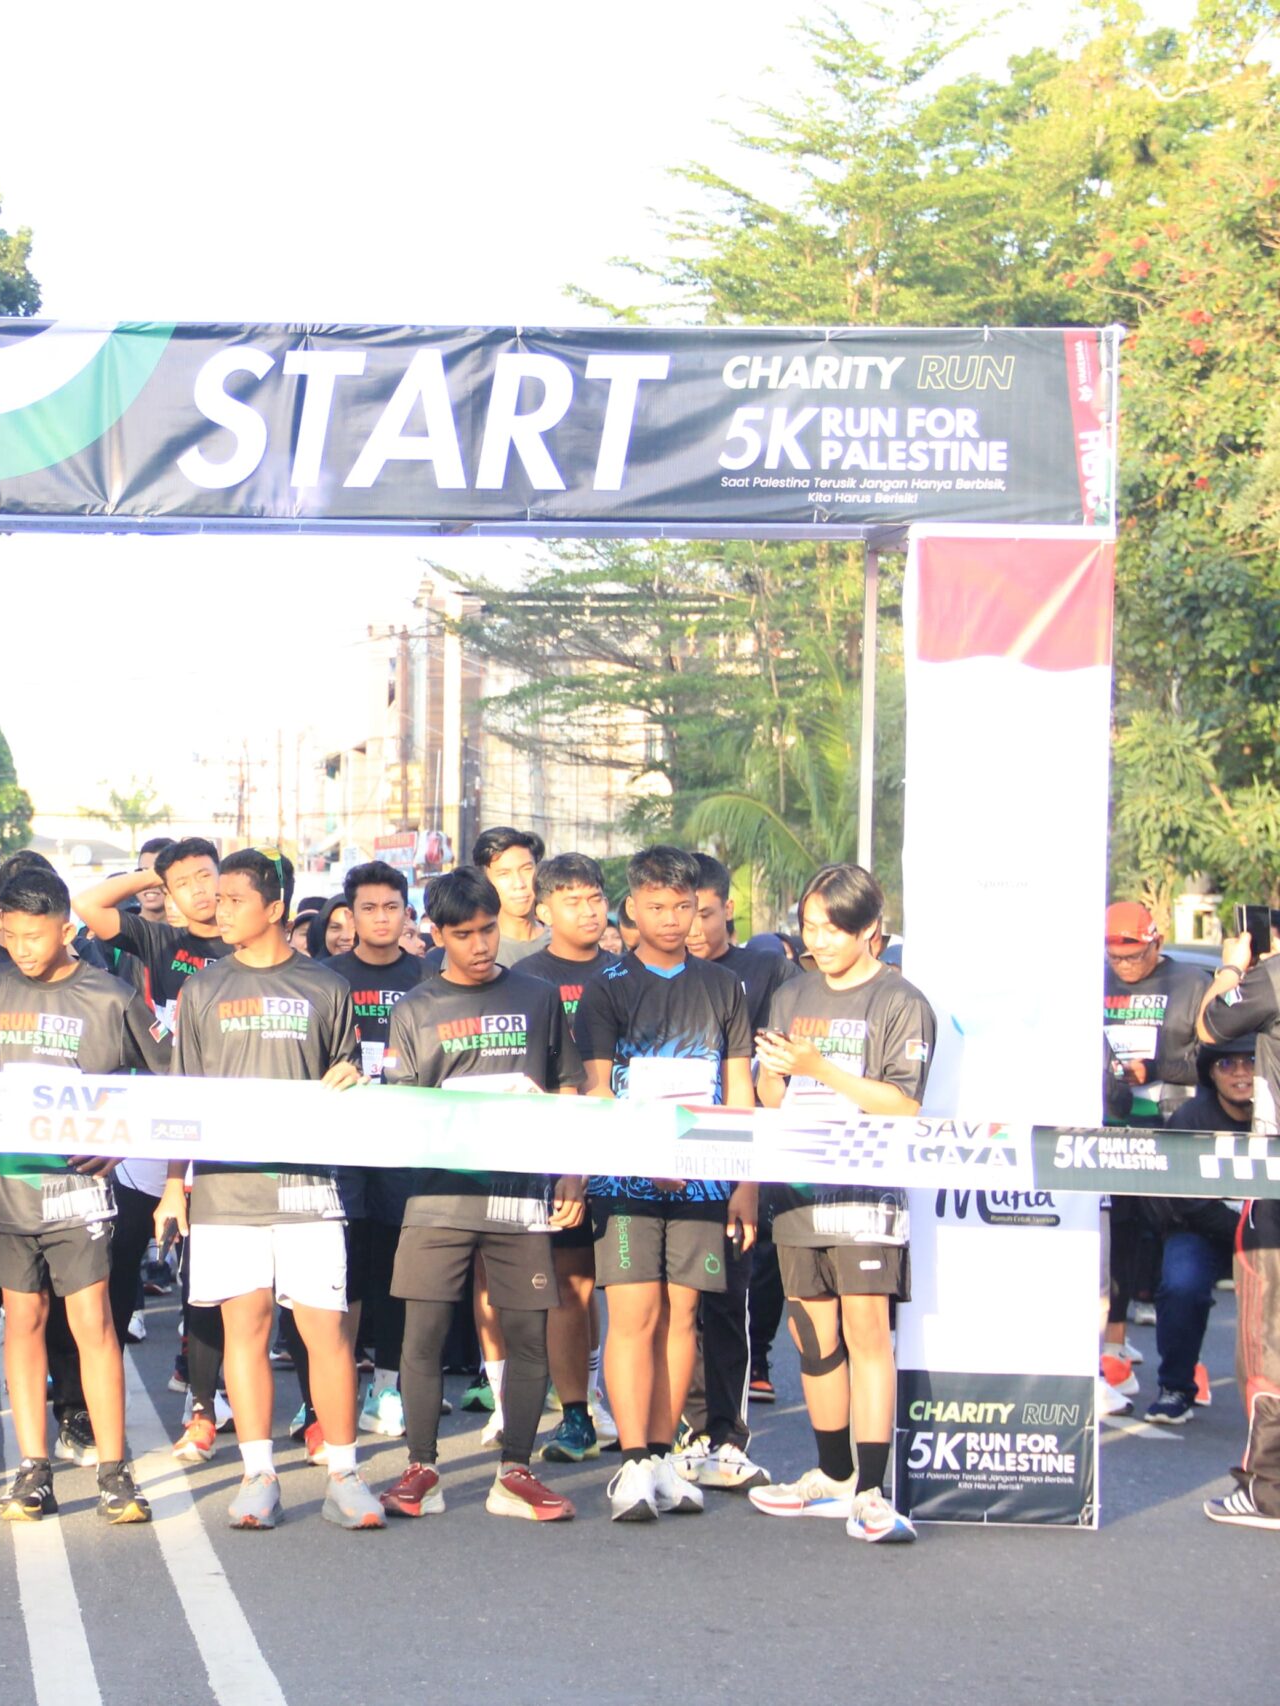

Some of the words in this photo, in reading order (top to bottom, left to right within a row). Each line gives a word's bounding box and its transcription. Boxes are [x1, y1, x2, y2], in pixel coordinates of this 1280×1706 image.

[722, 355, 906, 390] CHARITY
[917, 355, 1015, 391] RUN
[176, 346, 671, 492] START
[821, 407, 897, 438] RUN
[907, 408, 980, 438] FOR
[718, 407, 820, 471] 5K
[821, 440, 1008, 471] PALESTINE
[721, 476, 749, 488] Saat
[753, 476, 810, 488] Palestina
[814, 476, 857, 489] Terusik
[860, 477, 907, 493] Jangan
[911, 478, 952, 493] Hanya
[955, 478, 1007, 491] Berbisik,
[808, 492, 831, 503] Kita
[835, 492, 871, 504] Harus
[875, 492, 918, 504] Berisik!
[219, 999, 261, 1018] RUN
[267, 1000, 305, 1015] FOR
[1133, 996, 1164, 1008] FOR
[221, 1015, 308, 1033] PALESTINE
[1104, 1009, 1164, 1020] ALESTINE
[42, 1016, 78, 1034] FOR
[437, 1016, 481, 1040] RUN
[484, 1016, 524, 1032] FOR
[442, 1033, 527, 1054] PALESTINE
[481, 1048, 510, 1057] CHARITY
[511, 1047, 527, 1055] RUN
[29, 1115, 132, 1144] GAZA
[918, 1143, 1018, 1167] GAZA
[1054, 1135, 1097, 1169] 5K
[1099, 1137, 1128, 1153] RUN
[1130, 1139, 1157, 1155] FOR
[674, 1156, 753, 1176] PALESTINE
[1099, 1153, 1169, 1171] PALESTINE
[909, 1401, 1016, 1424] CHARITY
[1022, 1403, 1080, 1426] RUN
[907, 1432, 966, 1470] 5K
[966, 1433, 1011, 1452] RUN
[1017, 1434, 1059, 1453] FOR
[966, 1453, 1075, 1473] PALESTINE
[926, 1472, 960, 1480] Palestina
[962, 1473, 987, 1481] Terusik
[989, 1474, 1017, 1483] Jangan
